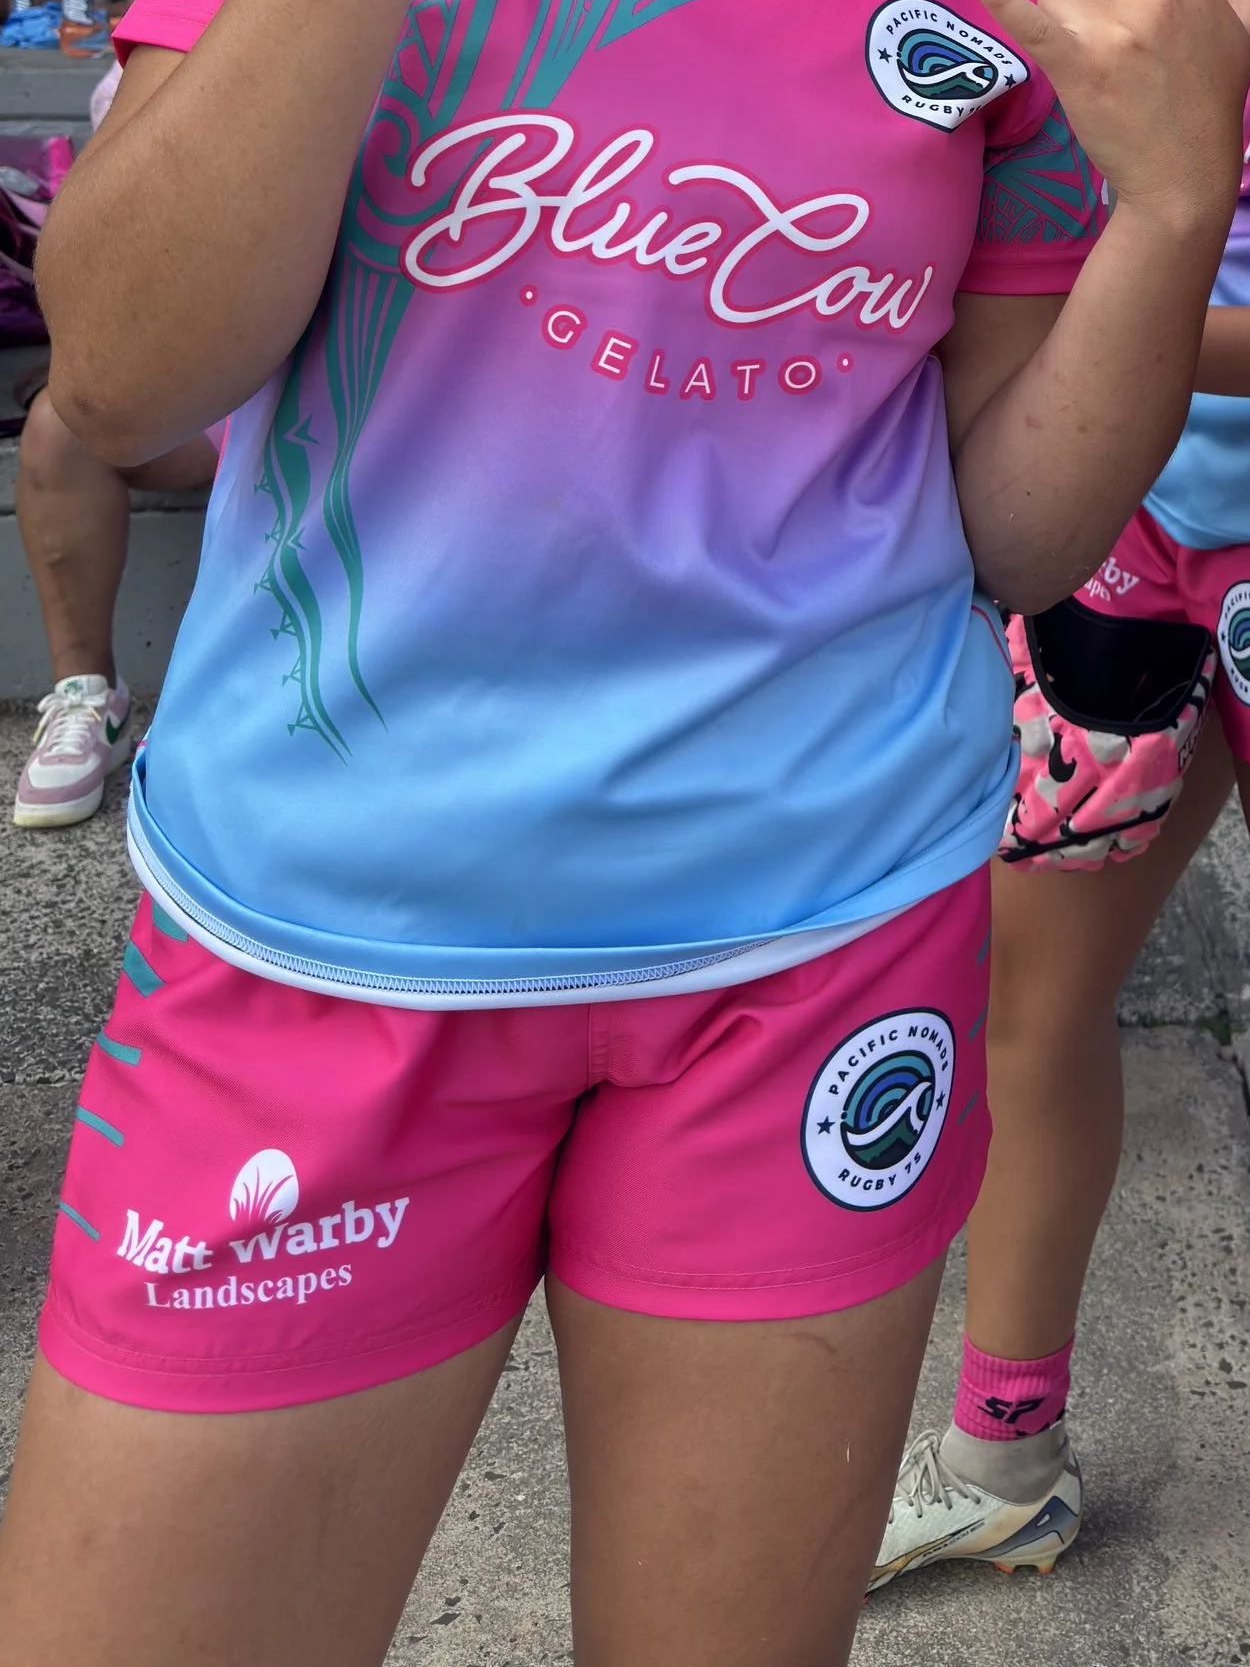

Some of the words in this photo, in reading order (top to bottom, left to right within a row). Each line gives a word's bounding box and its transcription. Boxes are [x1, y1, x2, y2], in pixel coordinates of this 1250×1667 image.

[886, 9, 938, 35] PACIFIC
[946, 20, 1013, 66] NOMADS
[901, 94, 964, 117] RUGBY
[404, 113, 722, 287] Blue
[668, 164, 934, 329] Cow
[547, 309, 817, 395] GELATO
[828, 1029, 898, 1096] PACIFIC
[908, 1025, 949, 1072] NOMADS
[838, 1168, 898, 1191] RUGBY
[116, 1208, 214, 1274] Matt
[229, 1197, 410, 1264] Warby
[144, 1264, 353, 1309] Landscapes
